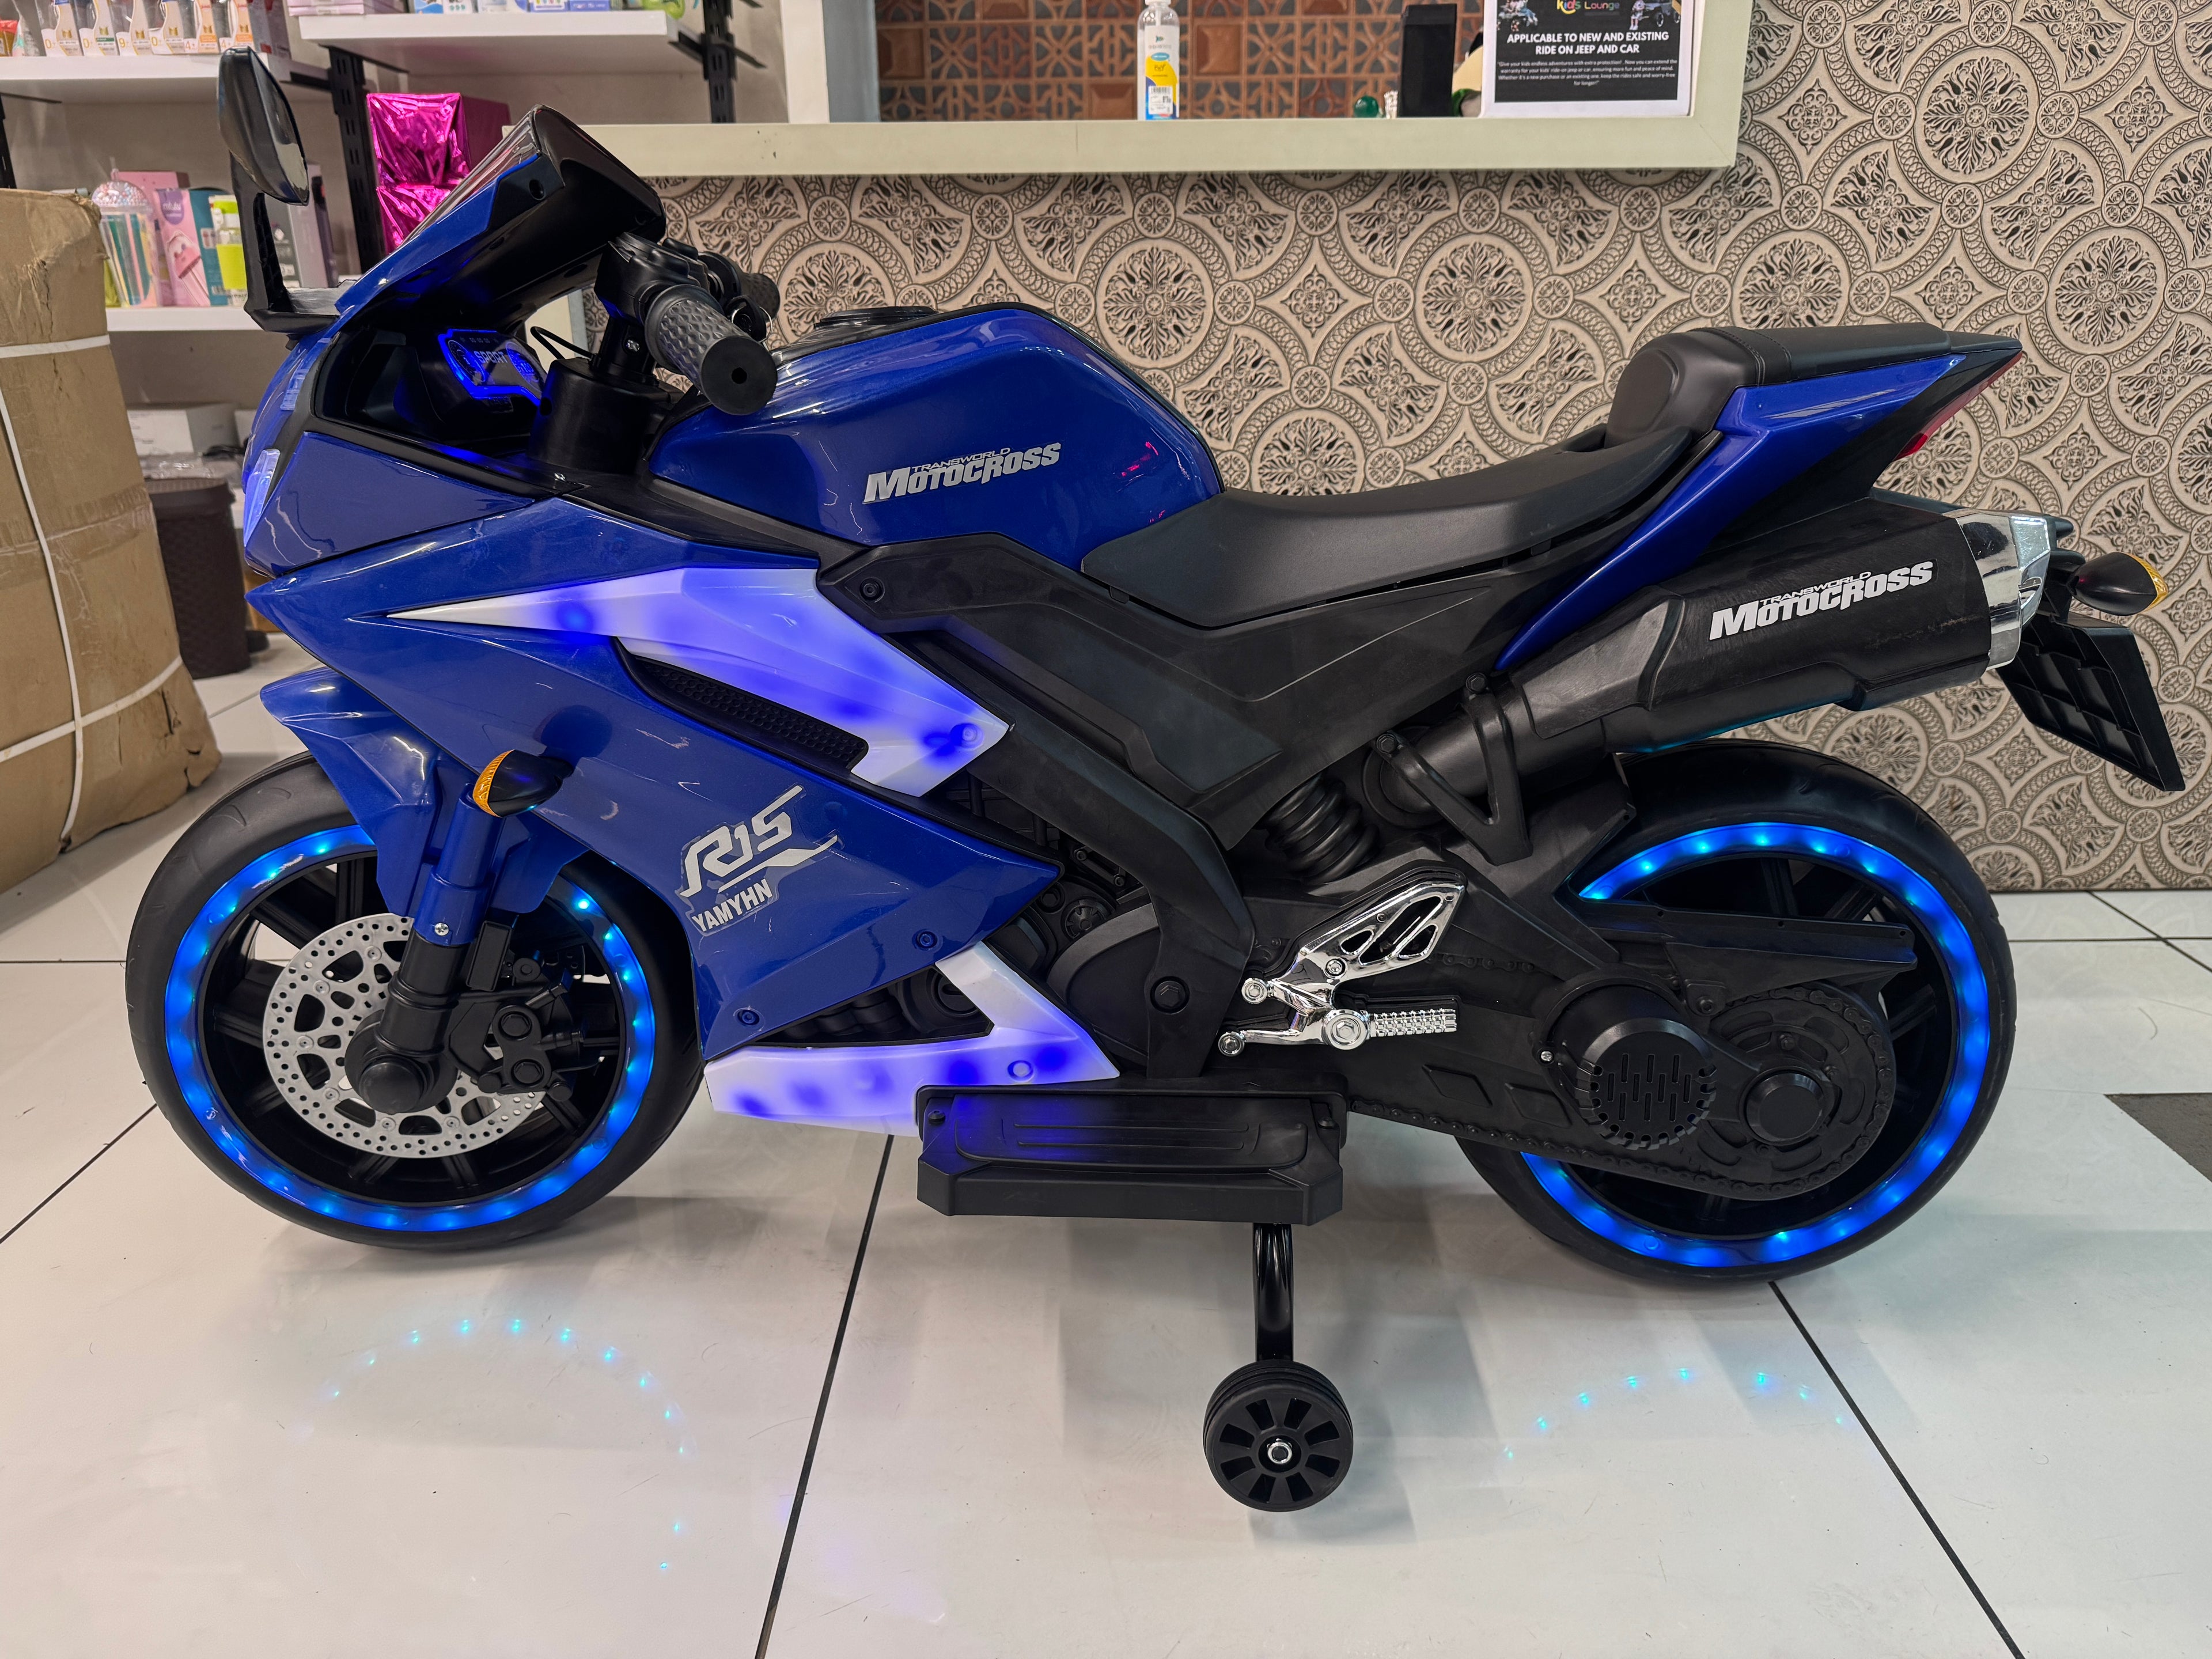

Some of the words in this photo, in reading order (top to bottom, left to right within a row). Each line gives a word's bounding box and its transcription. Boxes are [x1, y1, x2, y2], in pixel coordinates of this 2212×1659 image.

[1585, 1, 1620, 10] Lounge
[1507, 33, 1562, 43] APPLICABLE
[1564, 33, 1577, 42] TO
[1579, 33, 1602, 42] NEW
[1603, 32, 1624, 41] AND
[1626, 31, 1669, 41] EXISTING
[1535, 46, 1556, 55] RIDE
[1558, 45, 1573, 54] ON
[1574, 45, 1596, 54] JEEP
[1597, 44, 1618, 54] AND
[1619, 44, 1640, 53] CAR
[474, 351, 508, 363] SPORT
[912, 447, 1011, 472] TRANSWORLD
[1760, 571, 1872, 605] TRANSWORLD
[691, 878, 773, 932] YAMYHN
